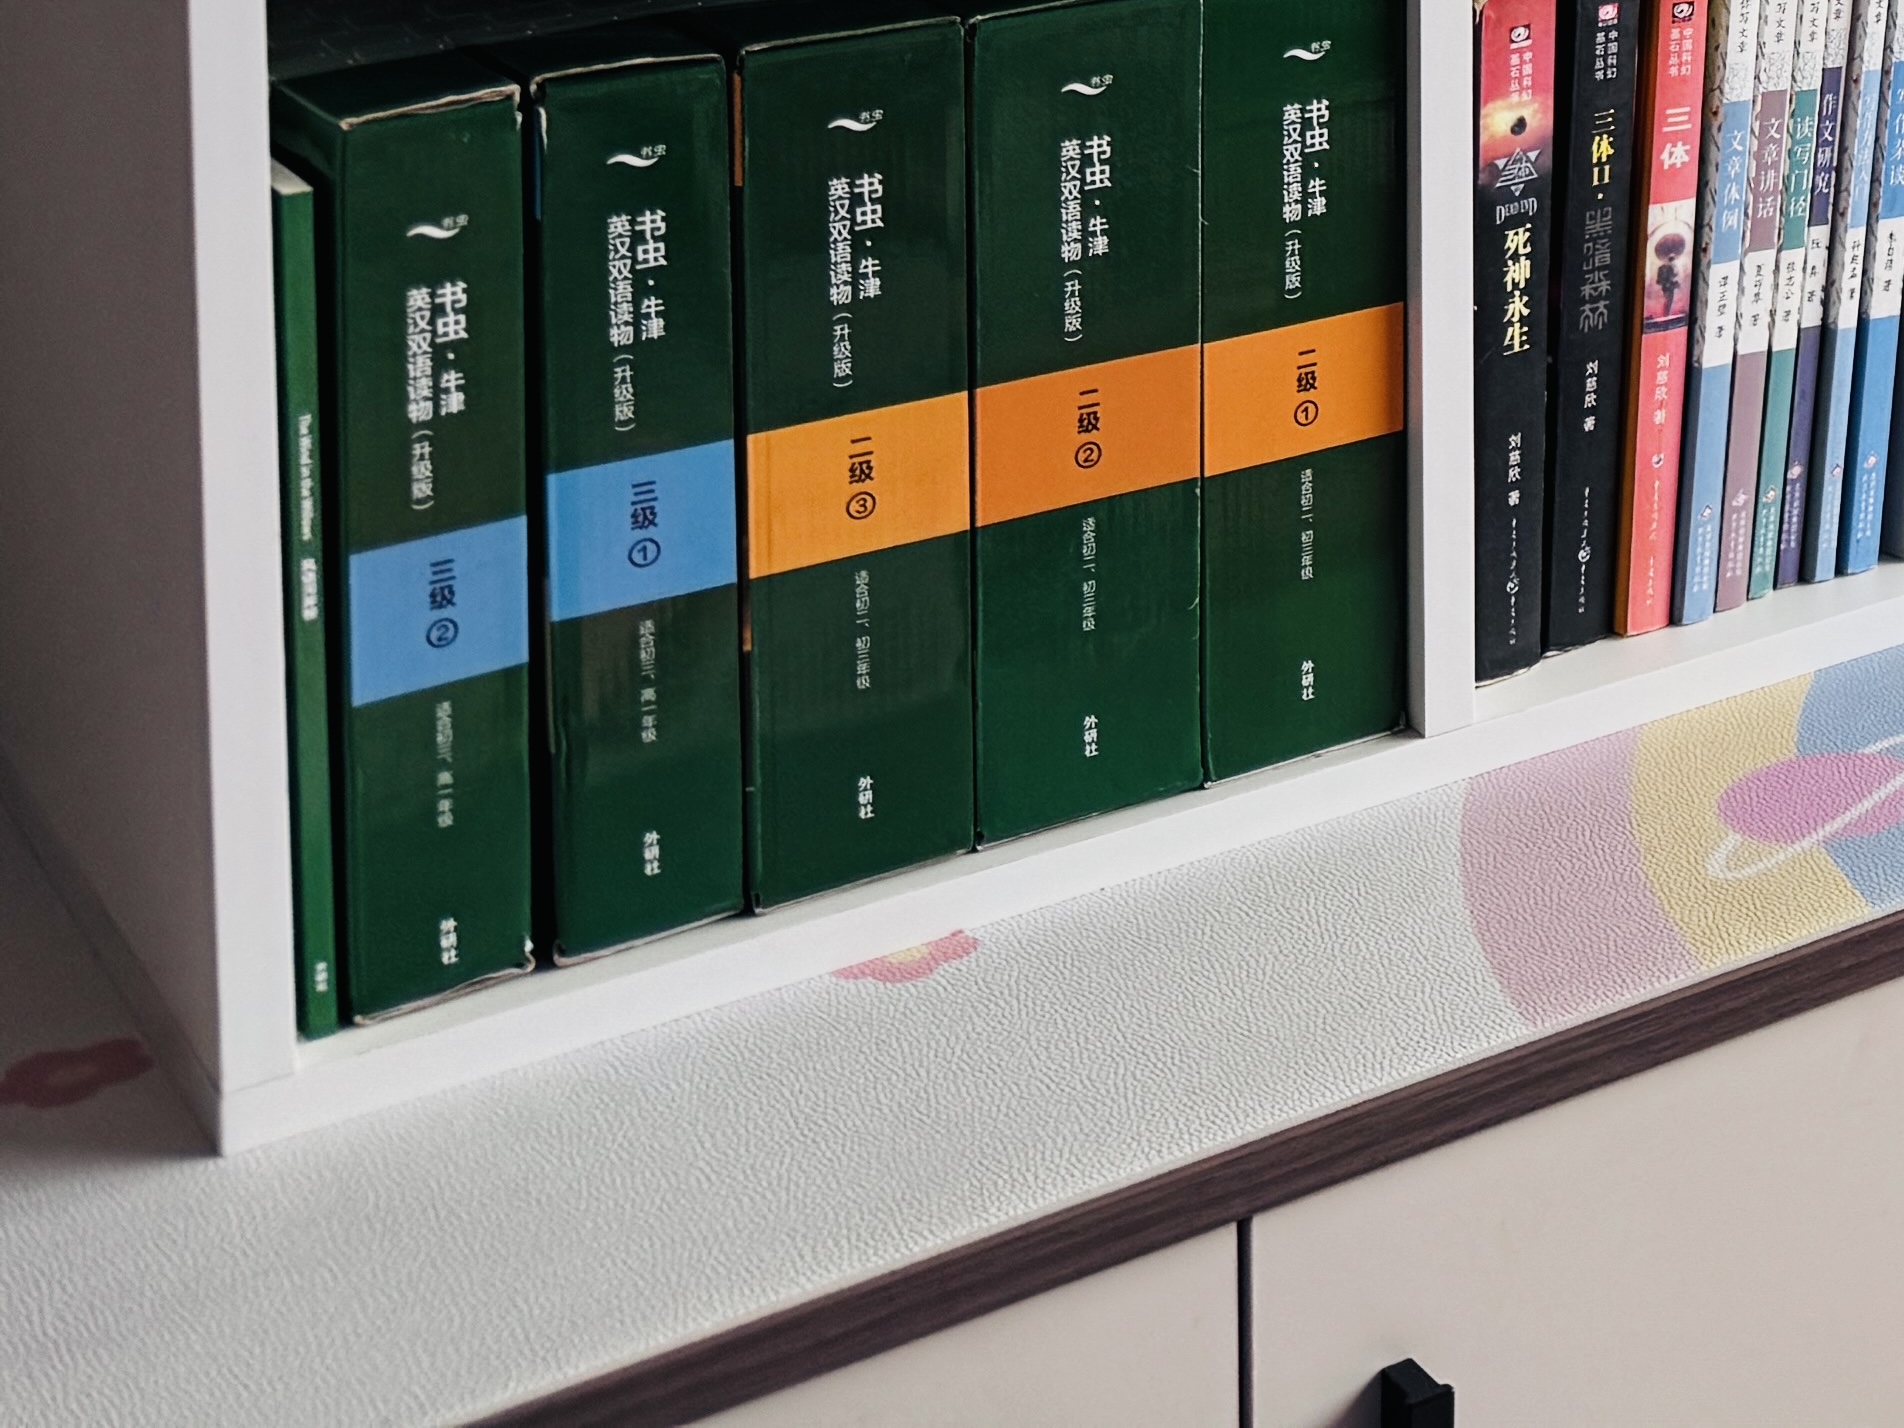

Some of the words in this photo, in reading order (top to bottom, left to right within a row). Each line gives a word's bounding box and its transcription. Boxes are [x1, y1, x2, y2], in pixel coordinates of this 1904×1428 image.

[1660, 106, 1693, 170] 三体
[1814, 93, 1837, 196] 作文研究
[1721, 130, 1743, 232] 文章体例
[1756, 117, 1782, 219] 文章讲话
[1787, 115, 1814, 219] 读写门径
[1503, 223, 1533, 357] 死神永生
[1585, 360, 1598, 409] 刘慈欣
[1656, 353, 1670, 400] 刘慈欣
[1508, 432, 1521, 483] 刘慈欣
[1300, 660, 1316, 701] 外研社
[1083, 715, 1099, 758] 外研社
[858, 776, 875, 820] 外研社
[643, 831, 661, 877] 外研社
[438, 917, 459, 965] 外研社
